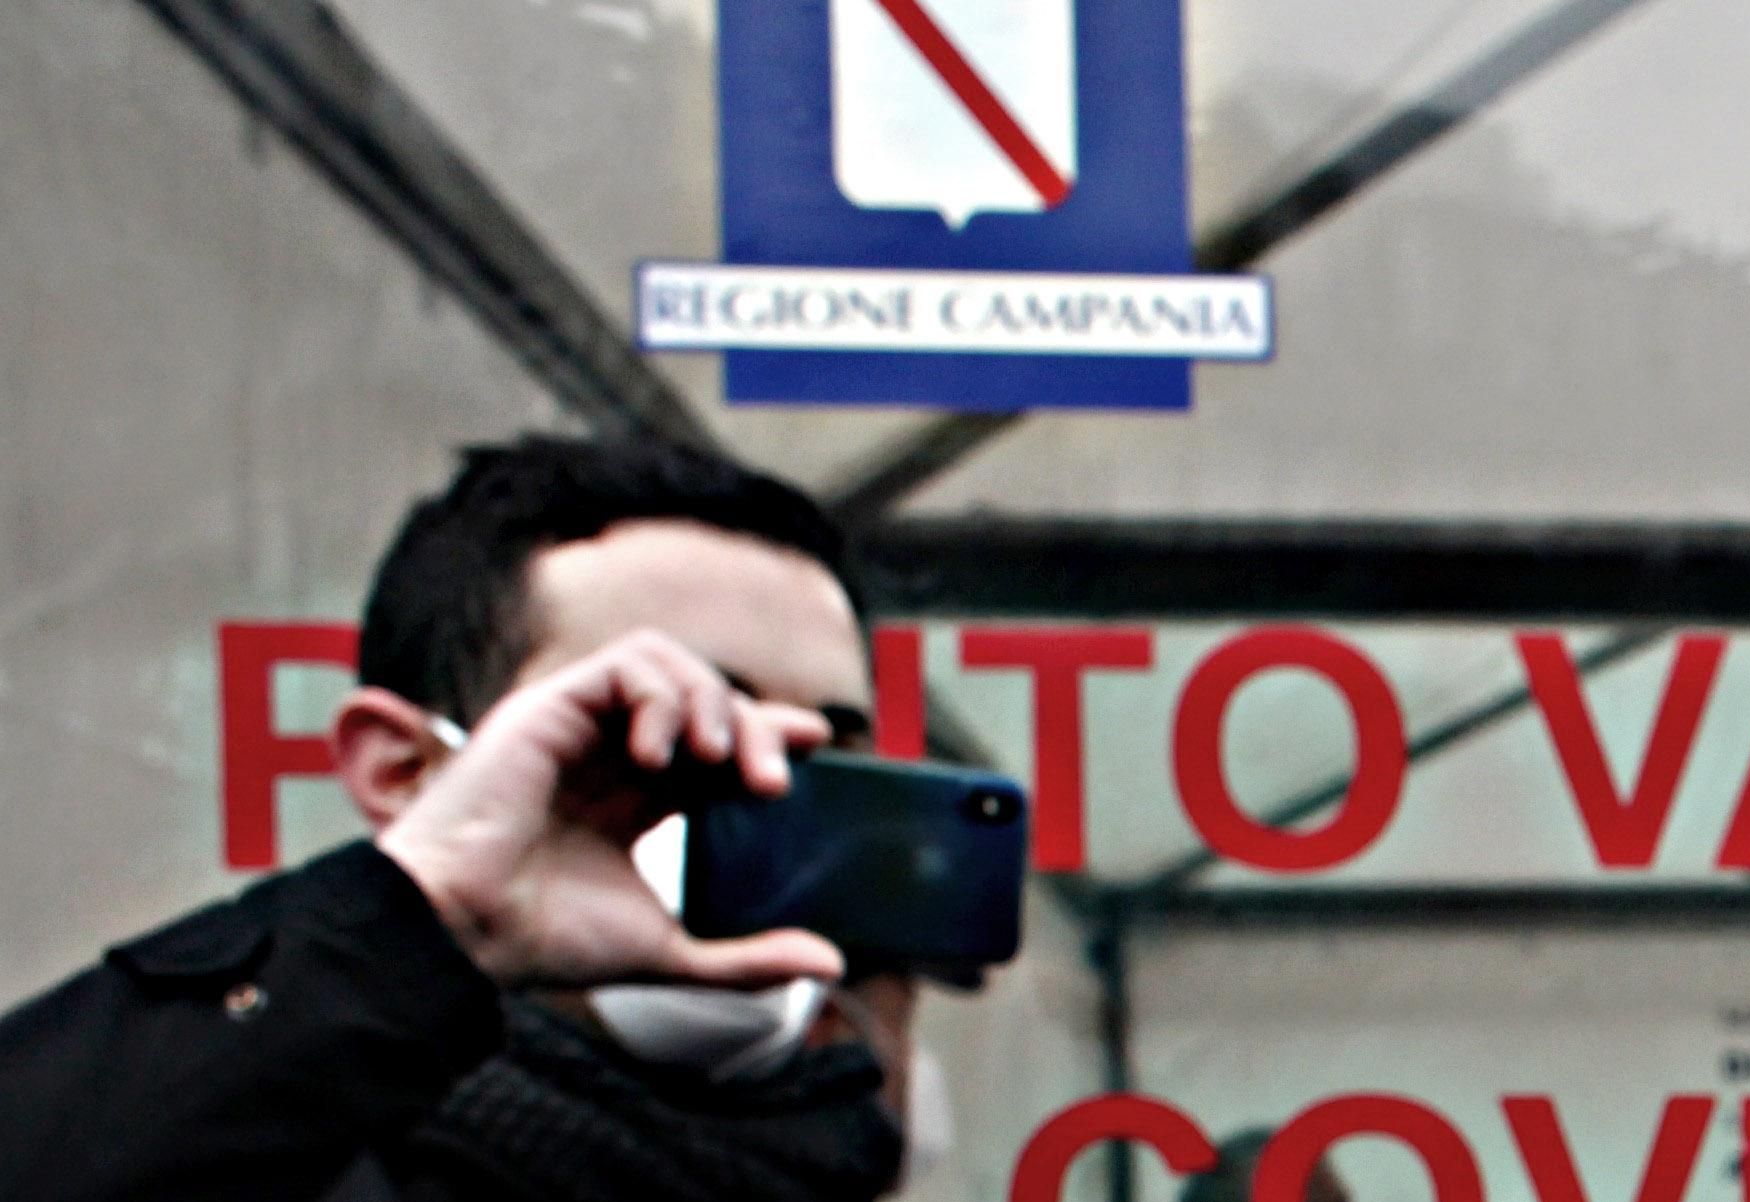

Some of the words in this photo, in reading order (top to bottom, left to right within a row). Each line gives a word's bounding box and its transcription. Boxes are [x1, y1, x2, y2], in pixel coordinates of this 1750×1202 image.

[650, 280, 911, 331] REGIONE
[938, 290, 1256, 338] CAMPANIA
[219, 622, 1407, 874] PTO
